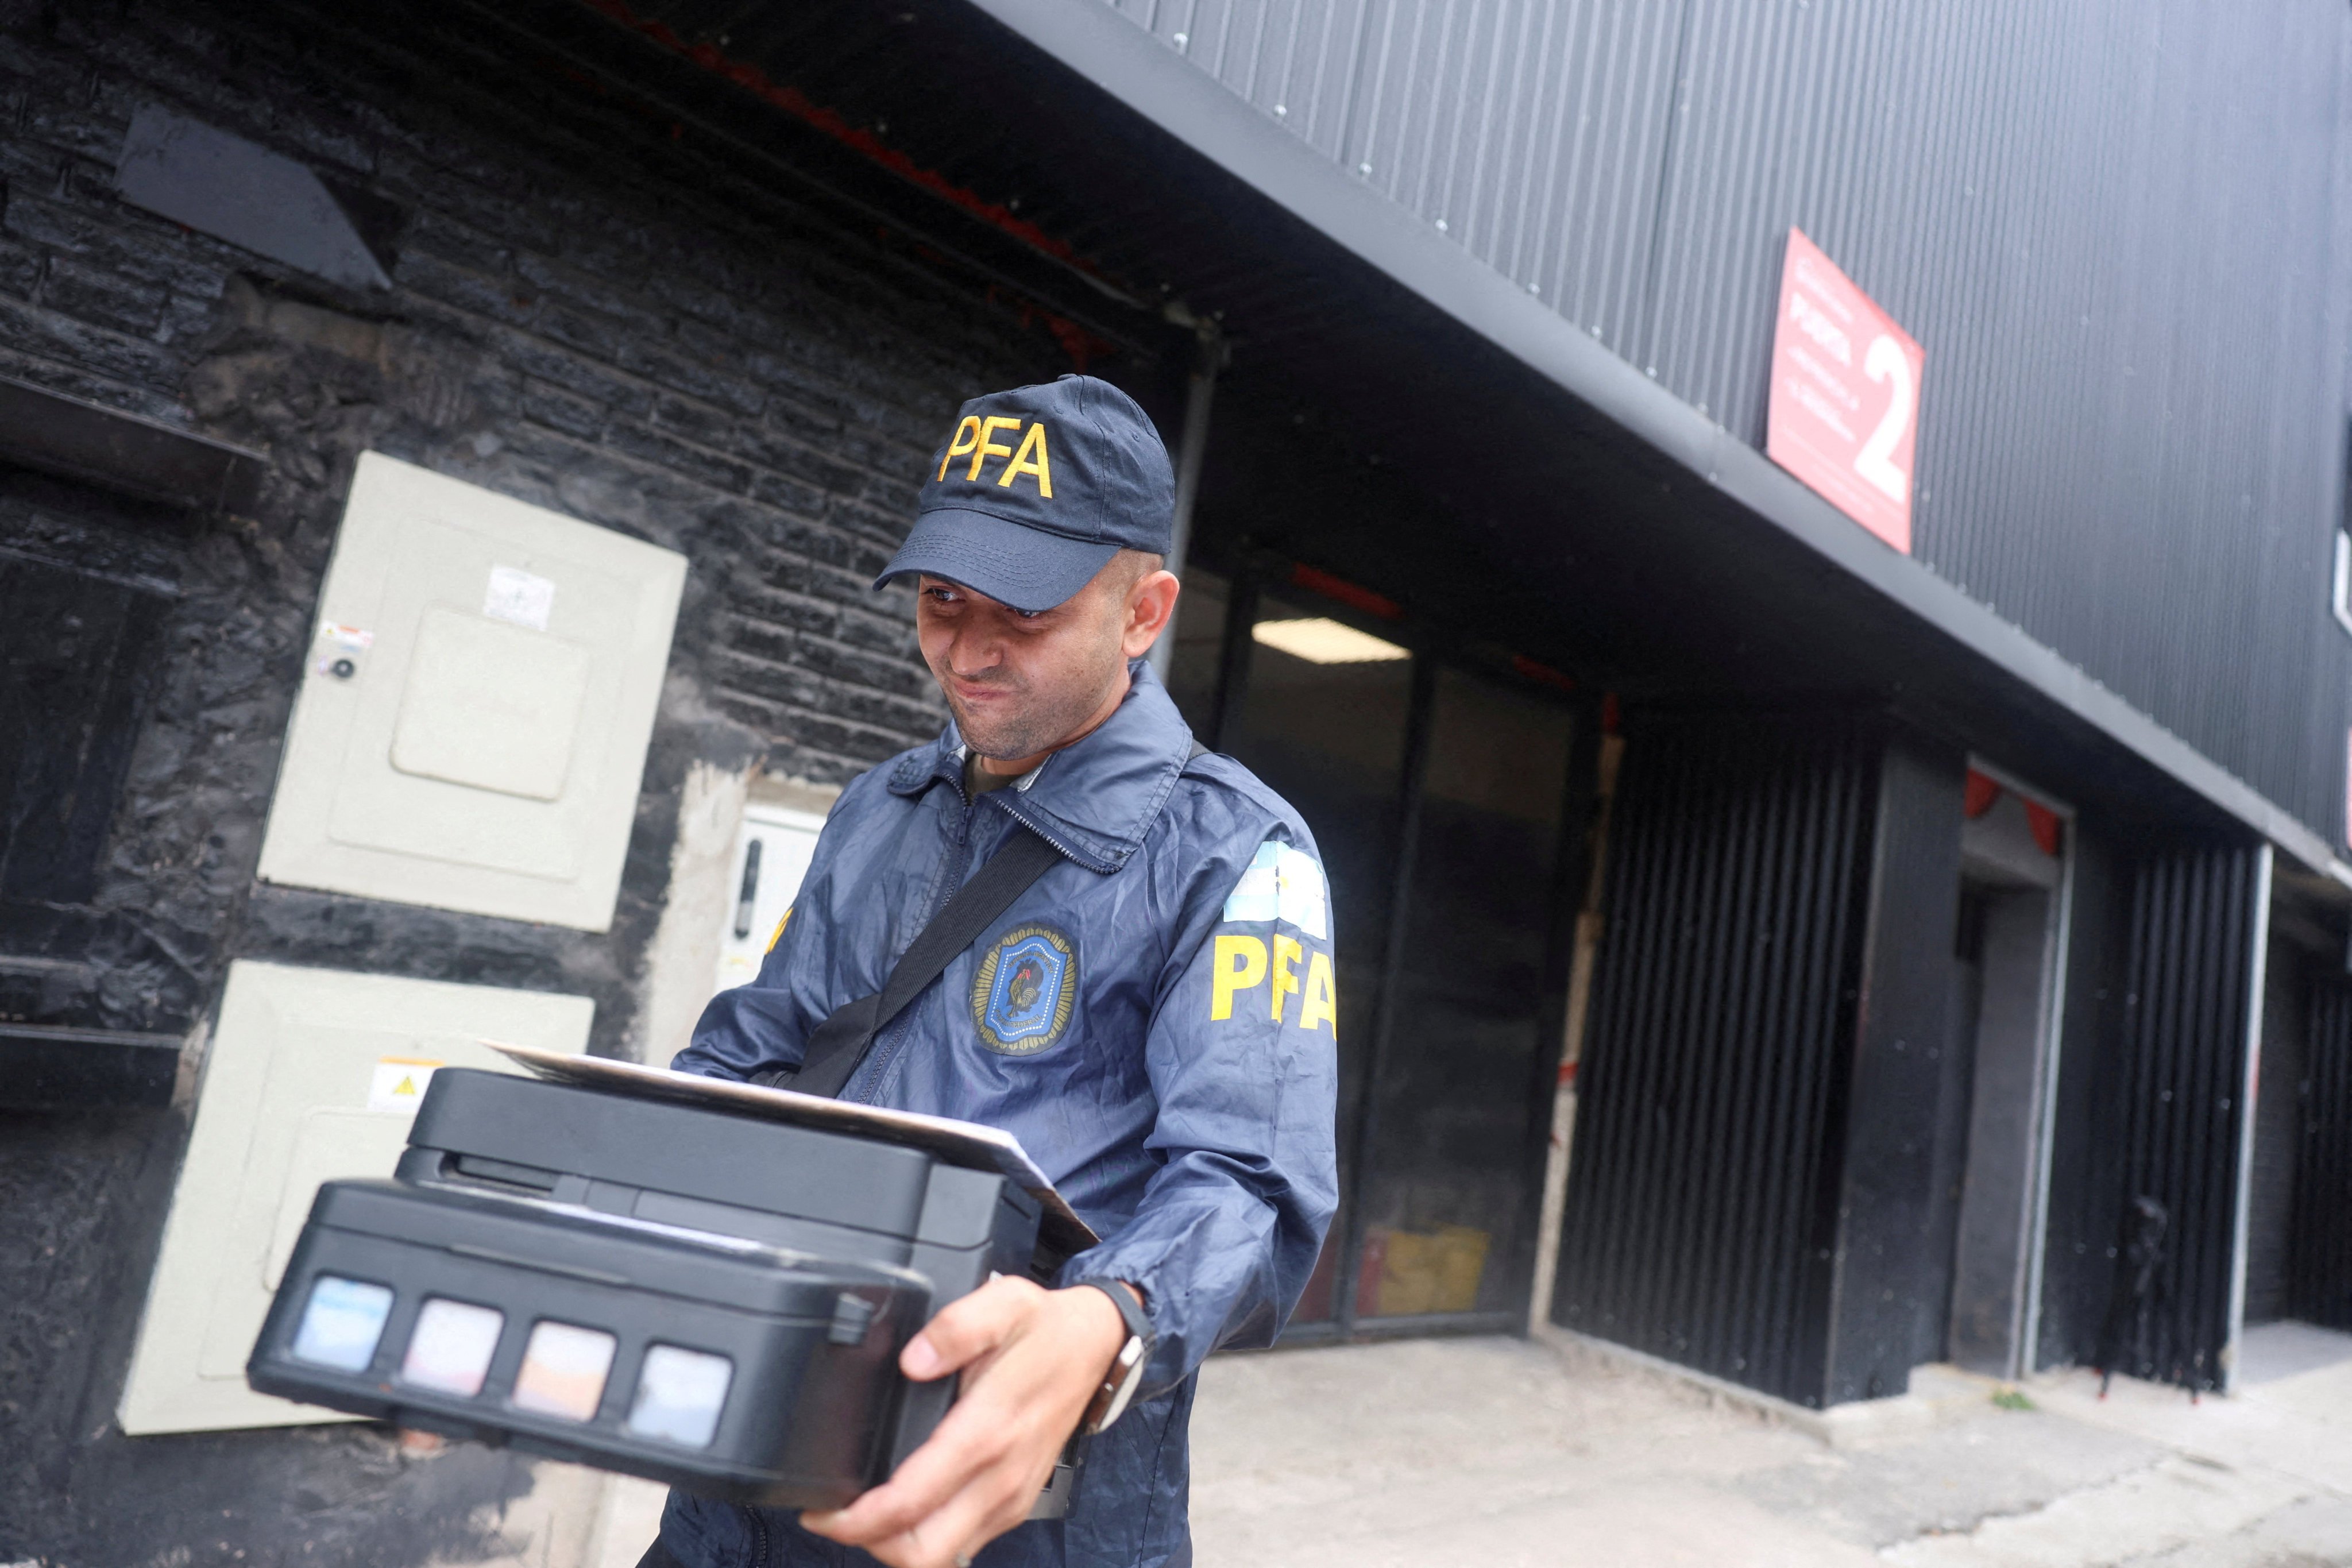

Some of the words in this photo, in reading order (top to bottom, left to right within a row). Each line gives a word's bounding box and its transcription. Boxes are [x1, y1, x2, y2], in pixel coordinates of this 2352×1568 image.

[937, 416, 1052, 499] PFA
[1854, 334, 1912, 504] 2
[1010, 1014, 1042, 1028] FEDERAL
[1211, 933, 1337, 1042] PFA
